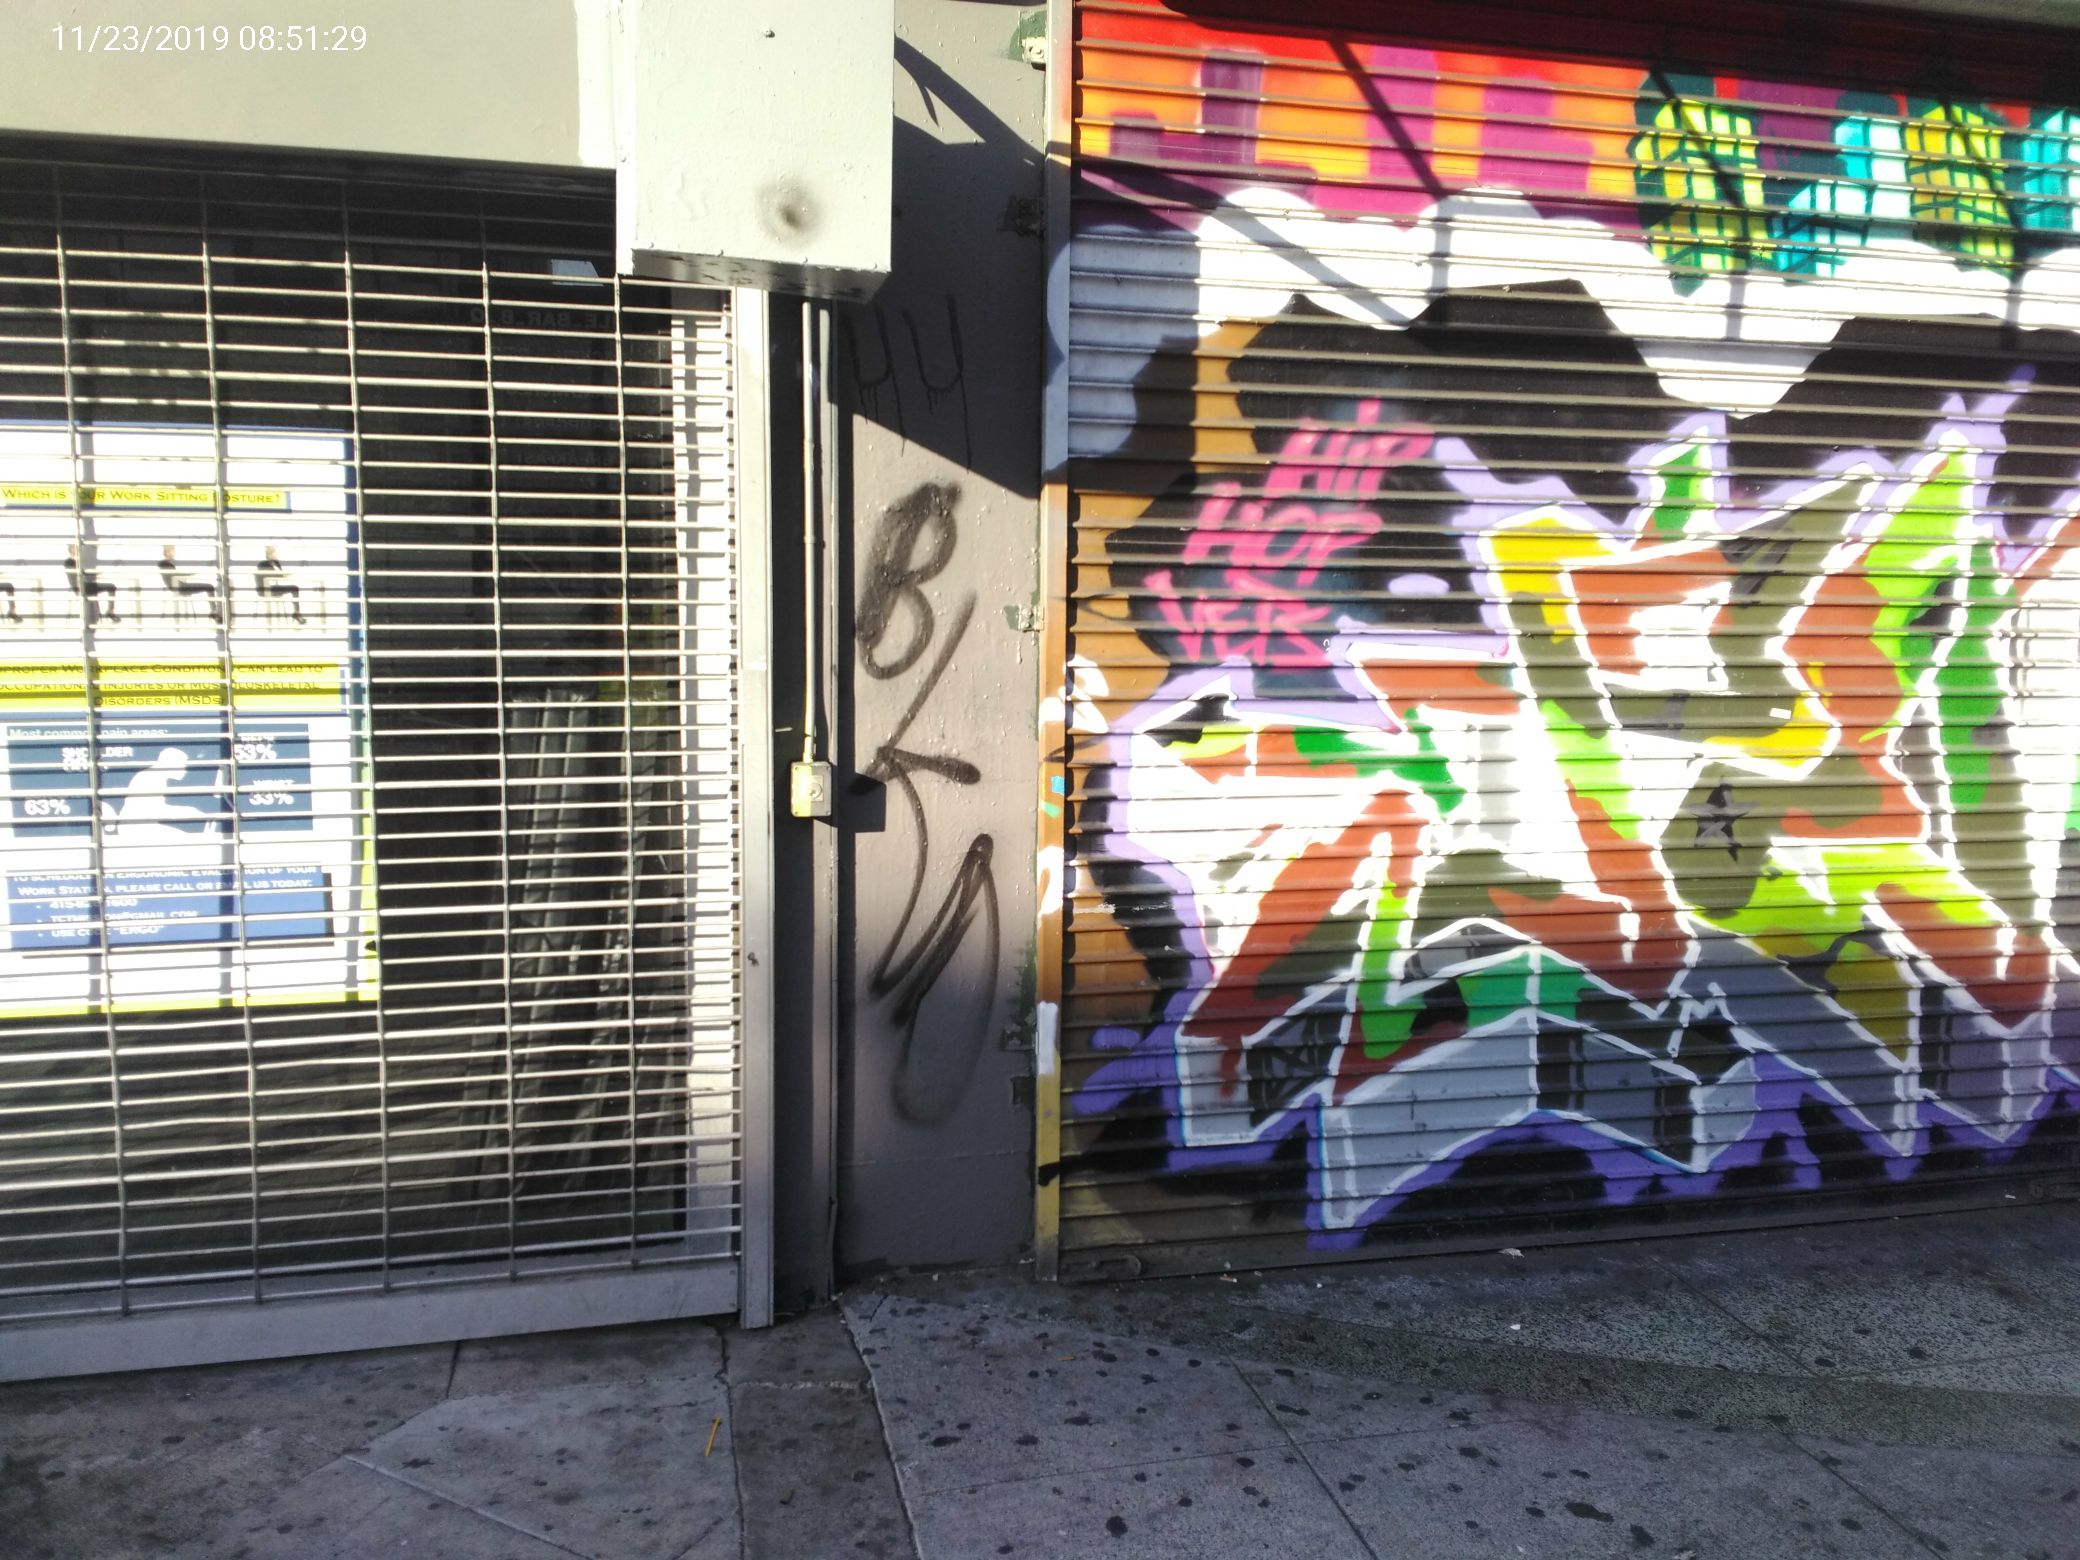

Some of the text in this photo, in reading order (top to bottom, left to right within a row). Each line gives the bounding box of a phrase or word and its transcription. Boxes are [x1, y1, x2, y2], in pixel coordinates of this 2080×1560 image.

[1183, 482, 1383, 588] HOP
[24, 798, 71, 815] 63%
[115, 883, 162, 893] PLEASE
[163, 882, 195, 892] CALL
